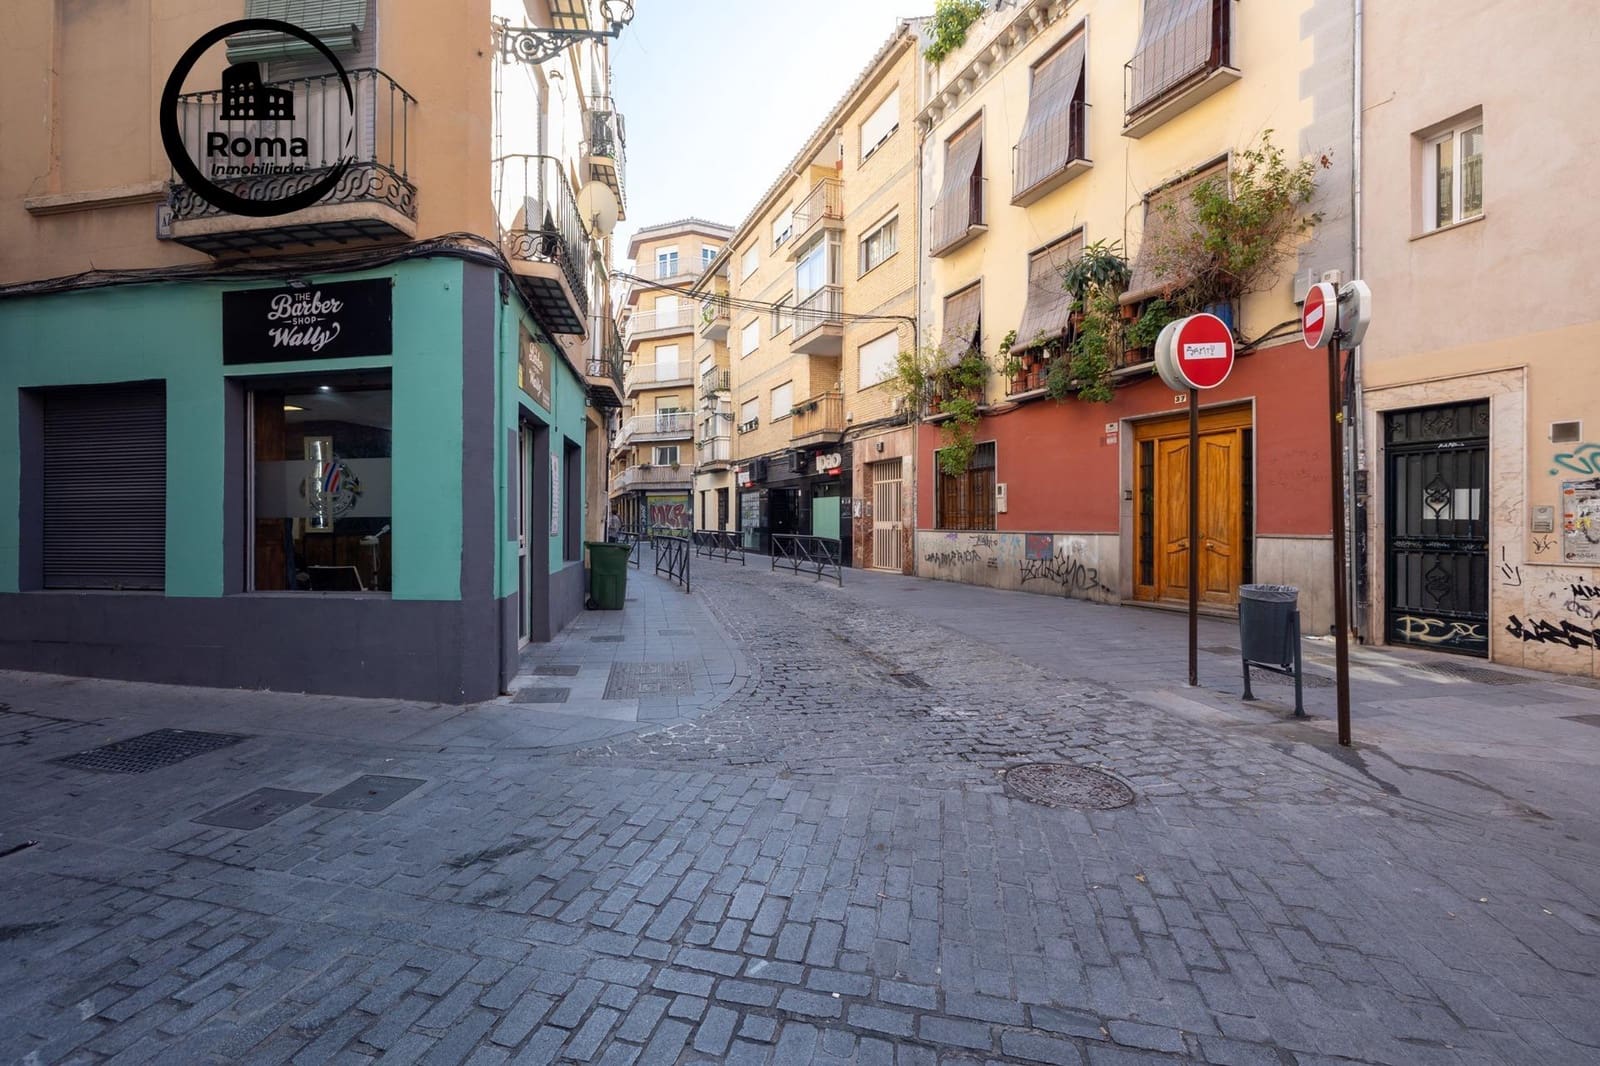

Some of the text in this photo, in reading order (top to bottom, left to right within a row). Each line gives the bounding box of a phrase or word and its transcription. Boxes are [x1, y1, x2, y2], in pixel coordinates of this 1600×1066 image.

[267, 290, 344, 321] Barber
[294, 292, 311, 301] THE
[292, 316, 317, 325] SHOP
[268, 321, 341, 352] Wally
